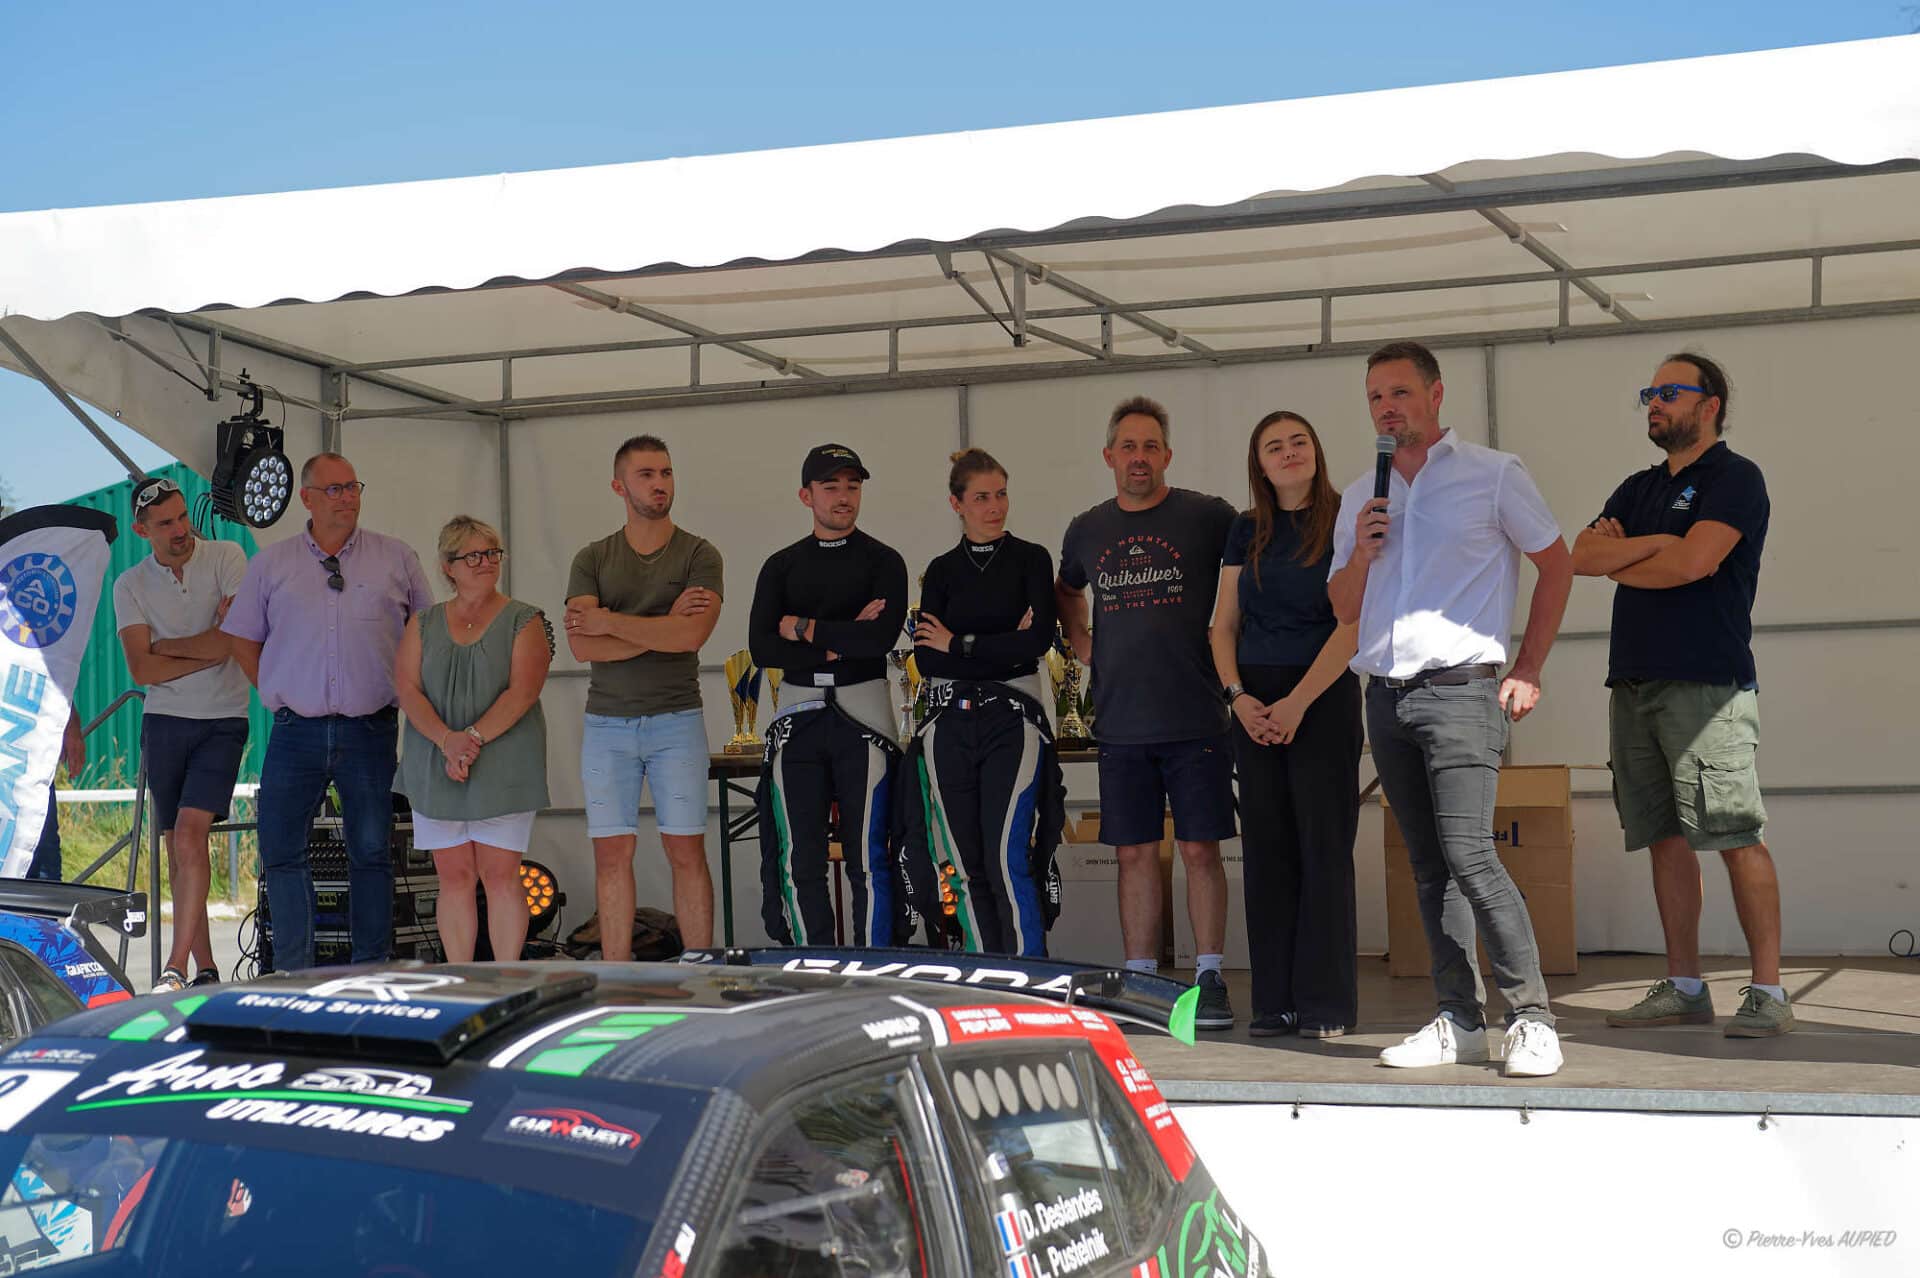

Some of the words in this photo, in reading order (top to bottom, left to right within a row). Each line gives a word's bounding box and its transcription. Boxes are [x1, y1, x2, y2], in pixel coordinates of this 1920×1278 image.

[1097, 566, 1184, 591] Quiksilver
[236, 993, 325, 1014] Racing
[325, 999, 441, 1020] Services
[205, 1097, 456, 1142] UTILITAIRES
[1019, 1208, 1039, 1240] D.
[1034, 1187, 1104, 1233] Deslandes
[1046, 1227, 1111, 1278] Pustelnik
